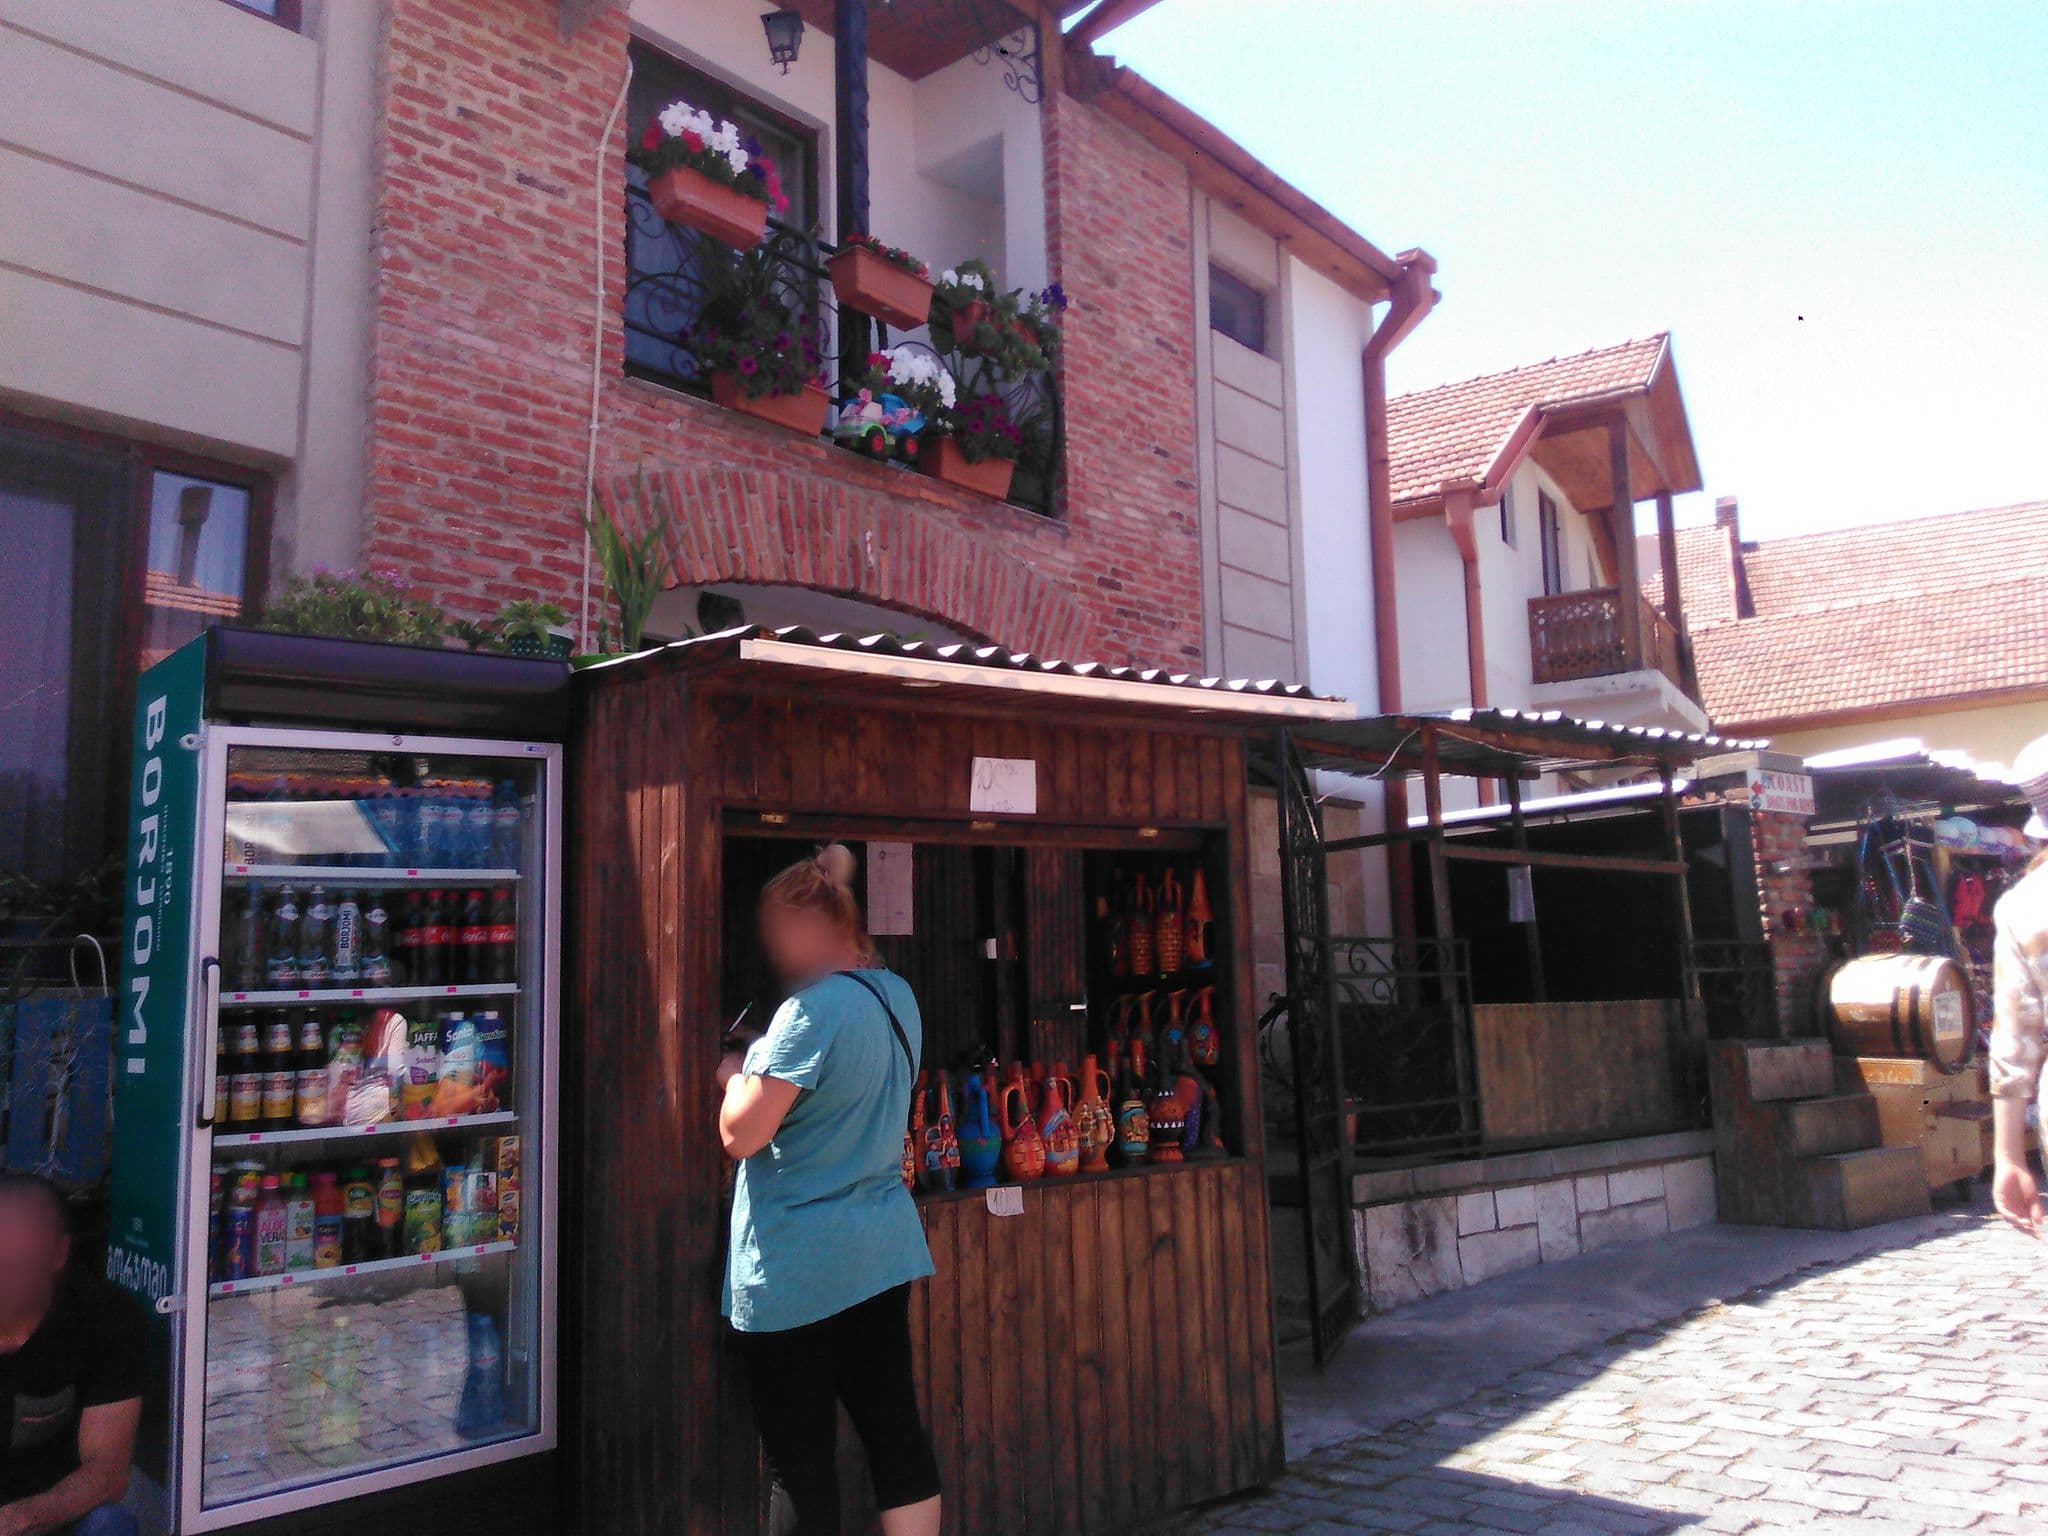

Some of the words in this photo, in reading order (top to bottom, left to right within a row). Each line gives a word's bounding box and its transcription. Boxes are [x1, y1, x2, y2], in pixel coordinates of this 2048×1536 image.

[127, 694, 167, 1073] BORJOMI
[164, 847, 174, 905] 1890
[340, 910, 352, 949] BORJOMI
